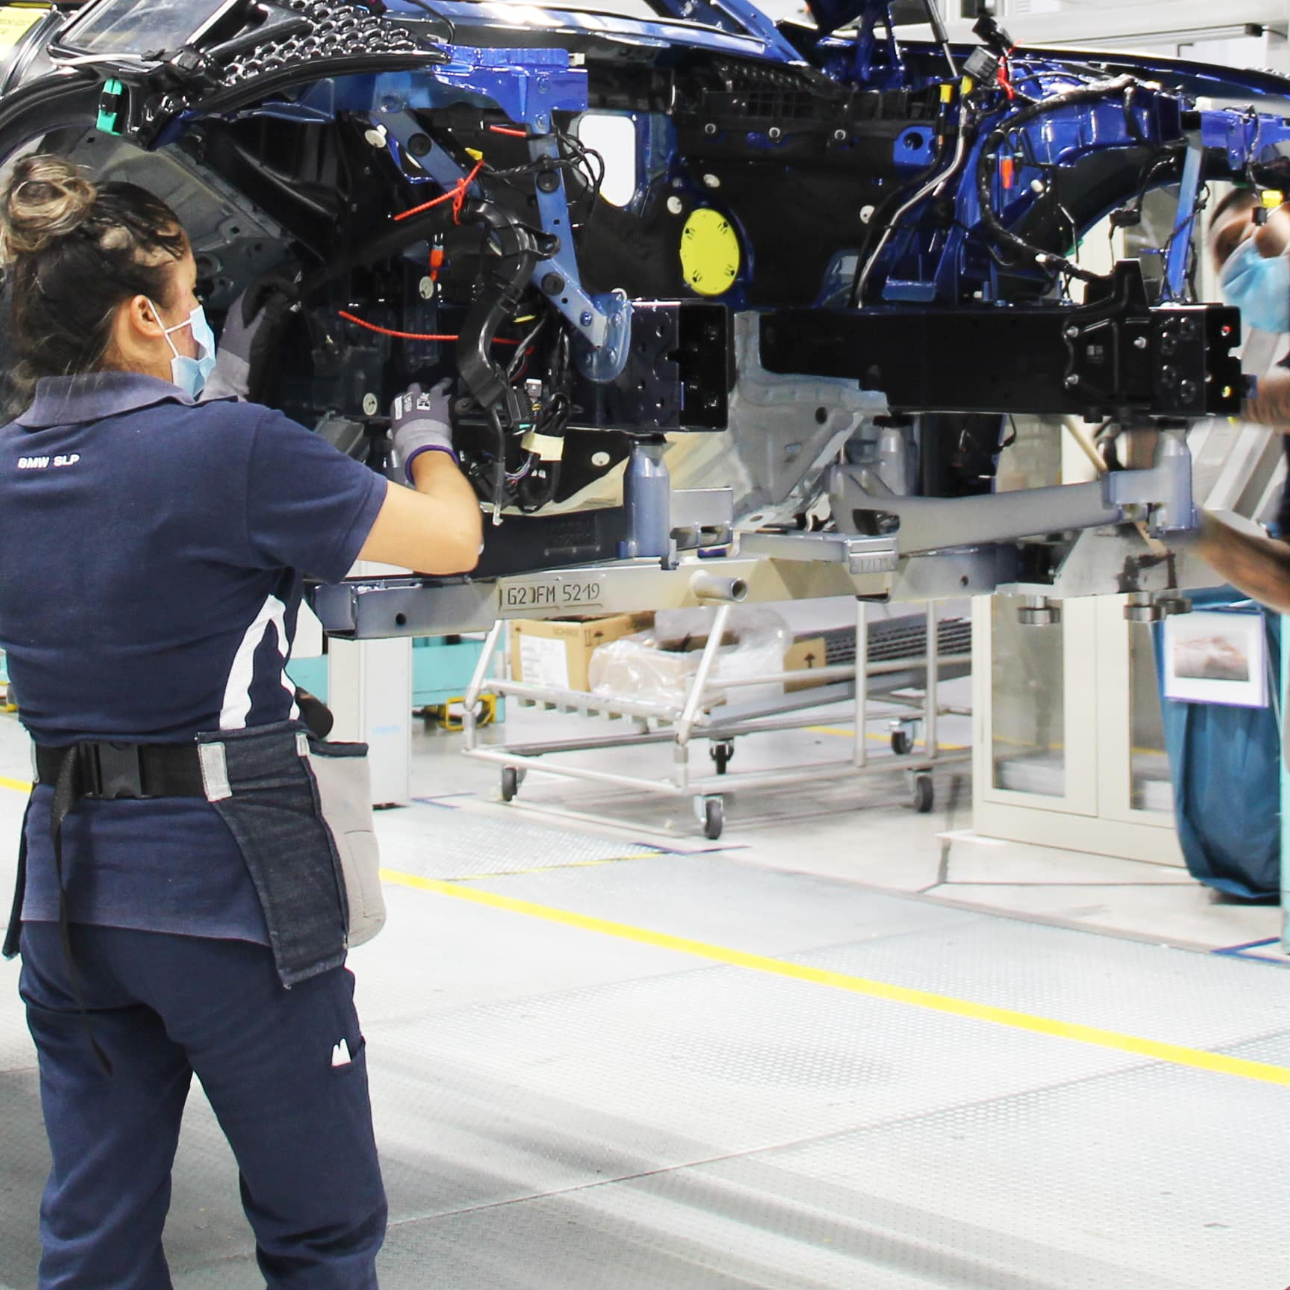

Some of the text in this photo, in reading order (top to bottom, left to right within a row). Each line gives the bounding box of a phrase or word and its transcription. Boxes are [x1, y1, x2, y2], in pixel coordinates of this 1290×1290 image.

[17, 453, 81, 469] BMW SLP
[561, 582, 601, 602] 5219
